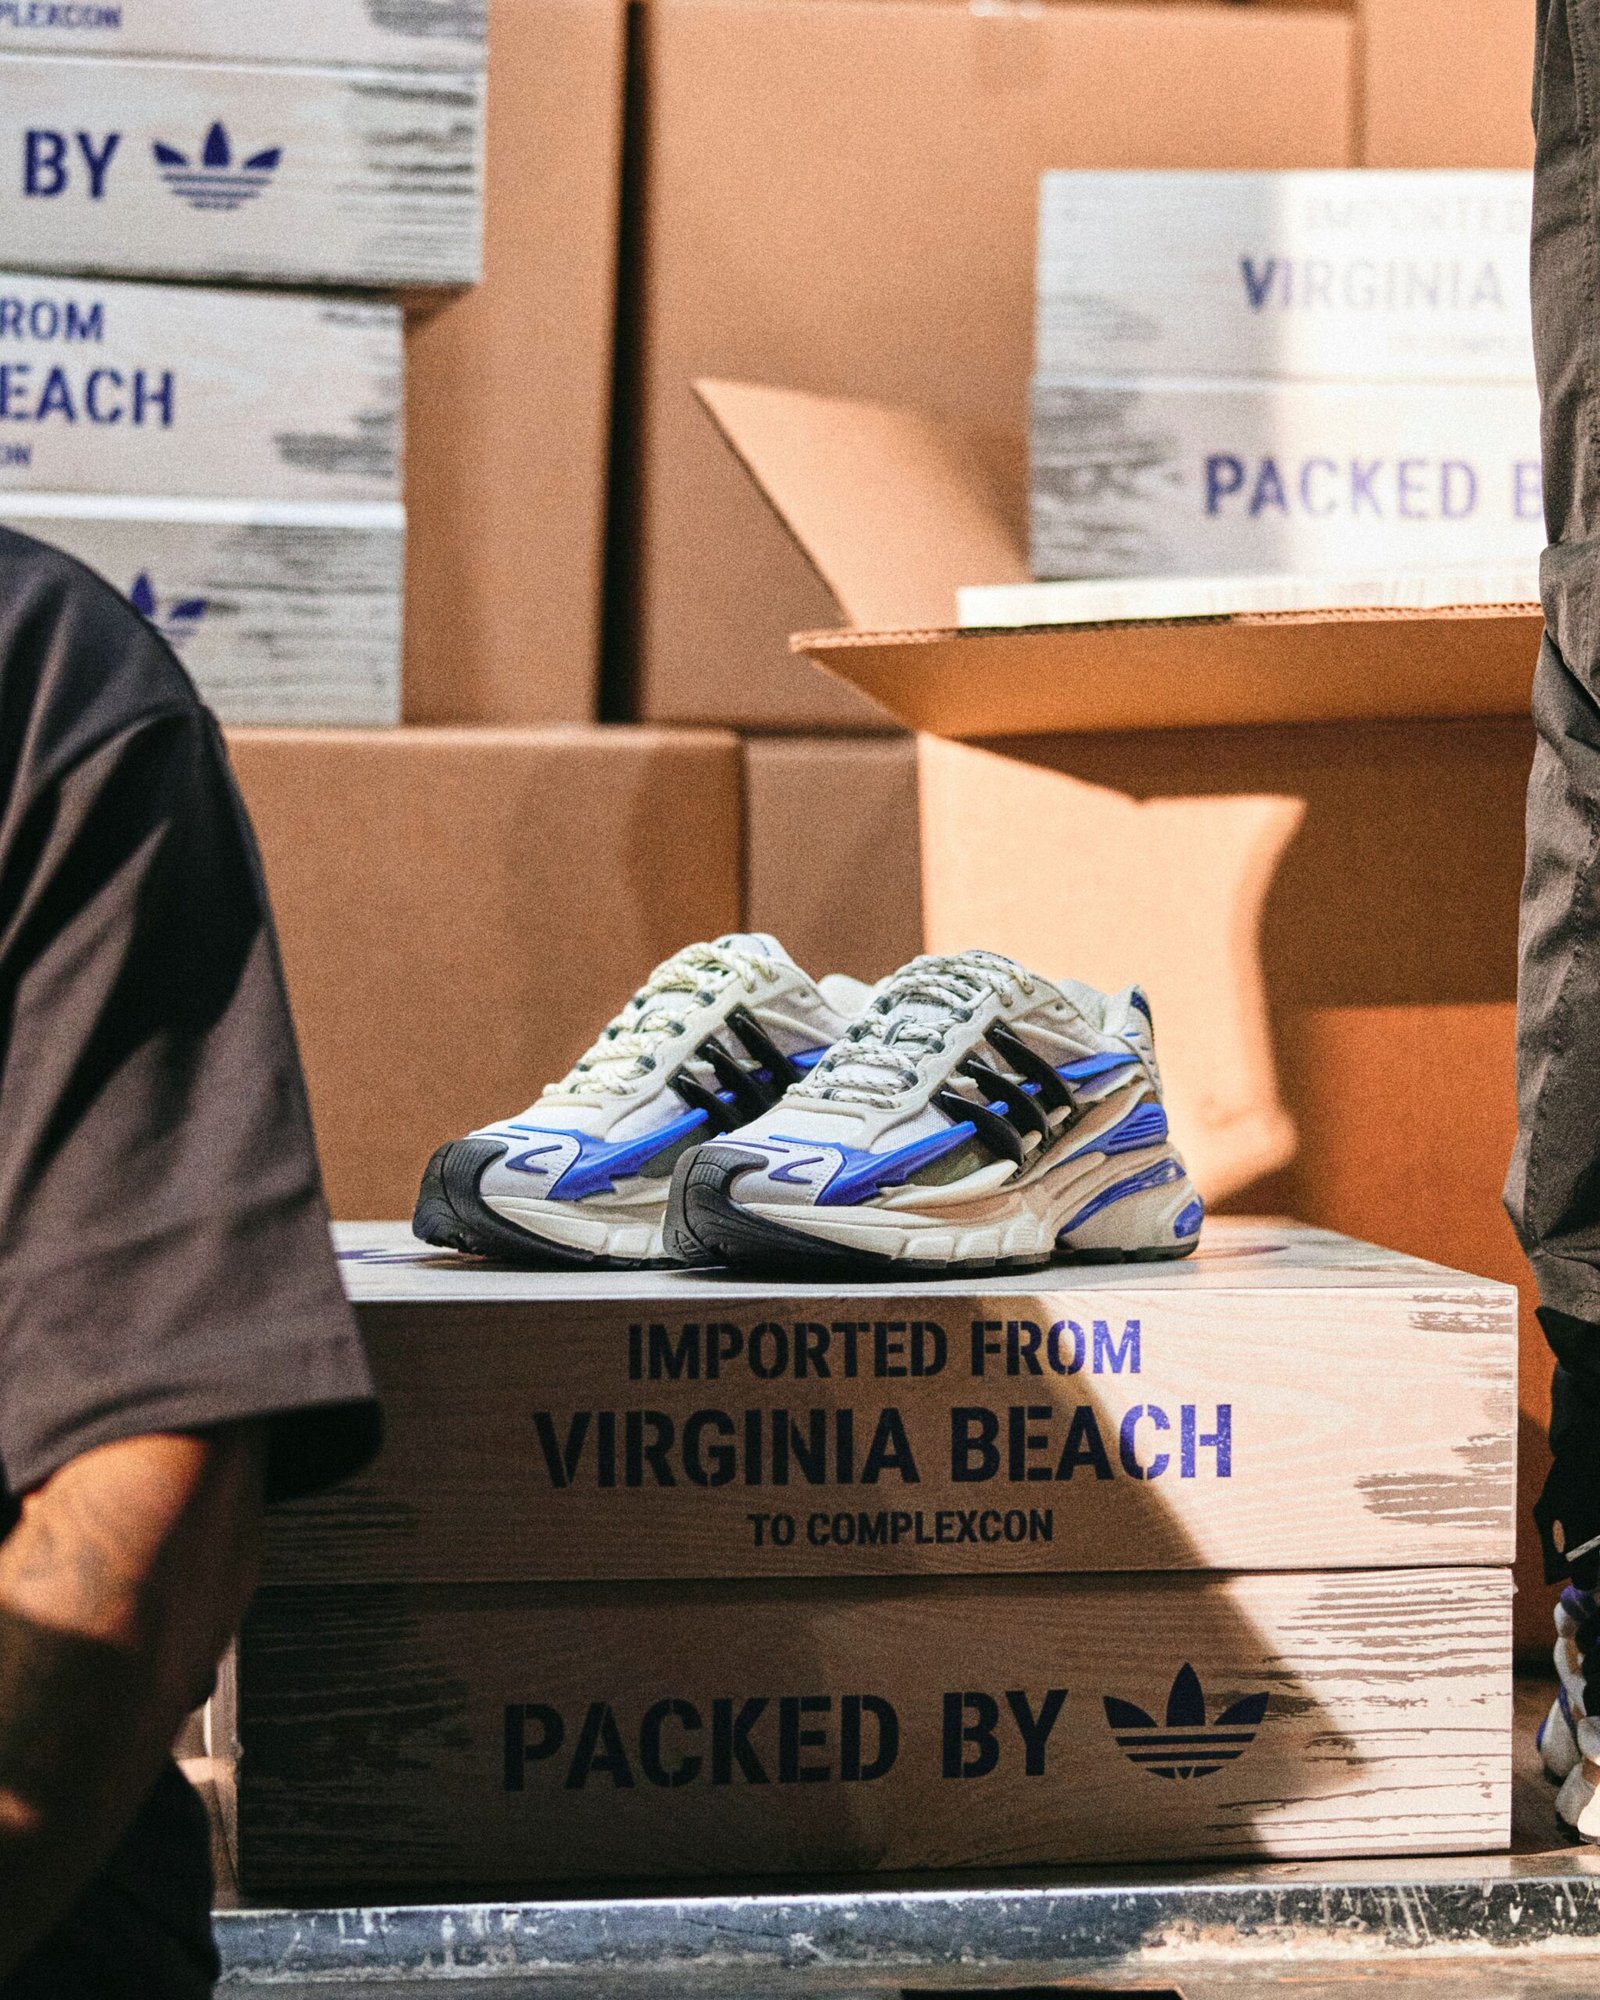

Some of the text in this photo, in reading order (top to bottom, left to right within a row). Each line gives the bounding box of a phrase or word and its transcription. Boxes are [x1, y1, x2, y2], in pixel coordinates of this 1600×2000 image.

[24, 128, 121, 200] BY
[1240, 257, 1504, 314] VIRGINIA
[0, 364, 174, 429] EACH
[1205, 453, 1478, 520] PACKED
[627, 1319, 1141, 1381] IMPORTED FROM
[532, 1404, 1233, 1489] VIRGINIA BEACH
[747, 1509, 1054, 1547] TO COMPLEXCON
[503, 1689, 1069, 1792] PACKED BY
